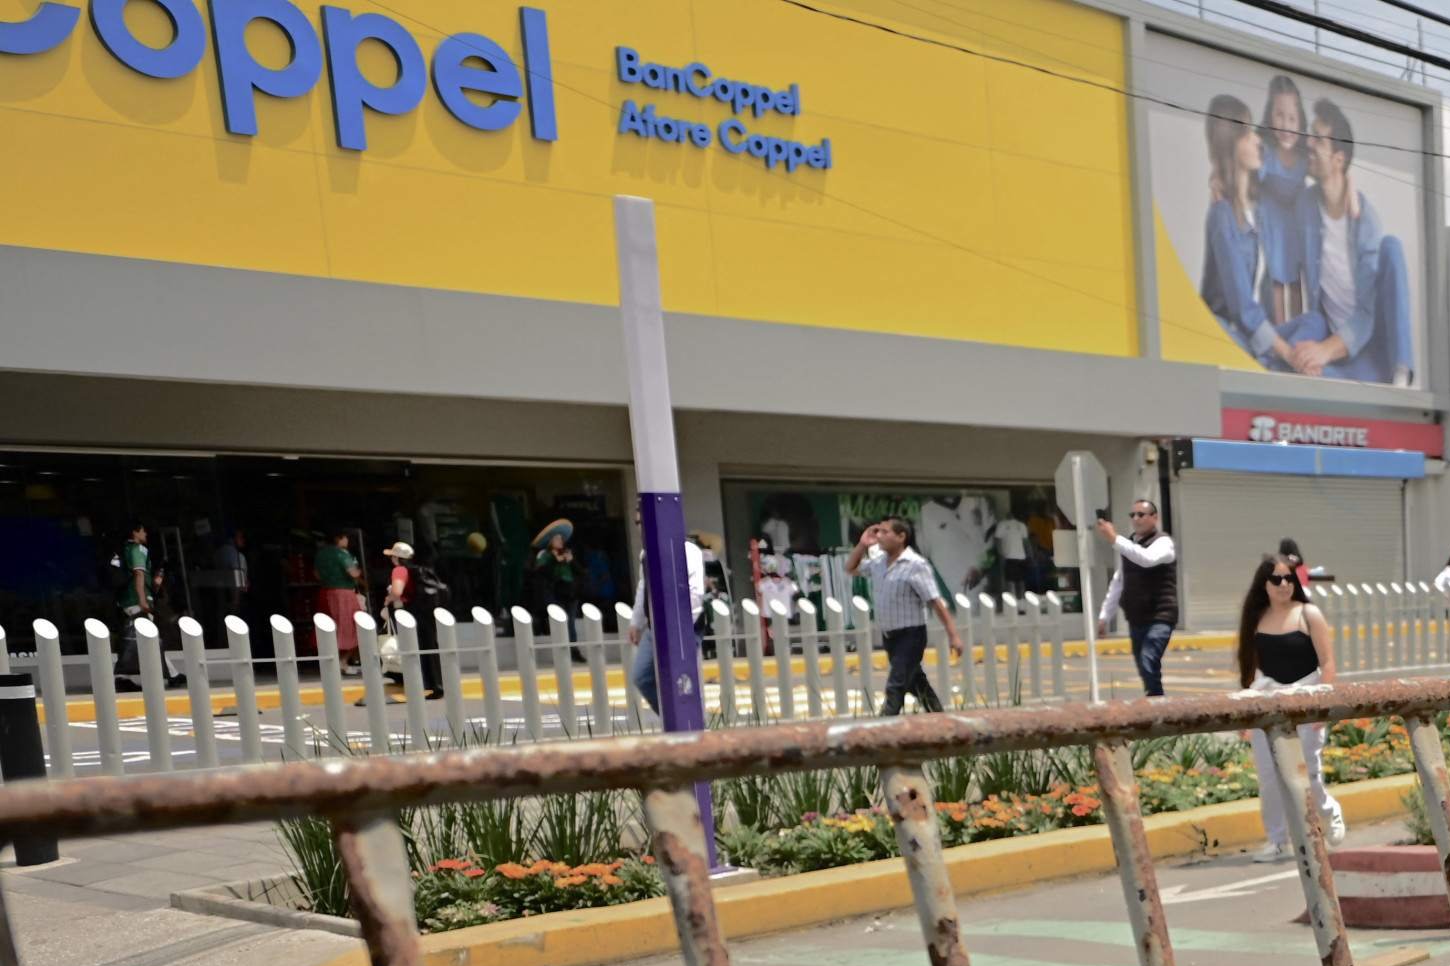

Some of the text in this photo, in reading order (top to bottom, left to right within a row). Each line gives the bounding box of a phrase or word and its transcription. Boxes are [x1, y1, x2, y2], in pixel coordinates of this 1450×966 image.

[0, 0, 557, 151] oppel
[616, 46, 801, 117] BanCoppel
[618, 99, 832, 173] Afore Coppel
[1279, 423, 1368, 446] BANORTE
